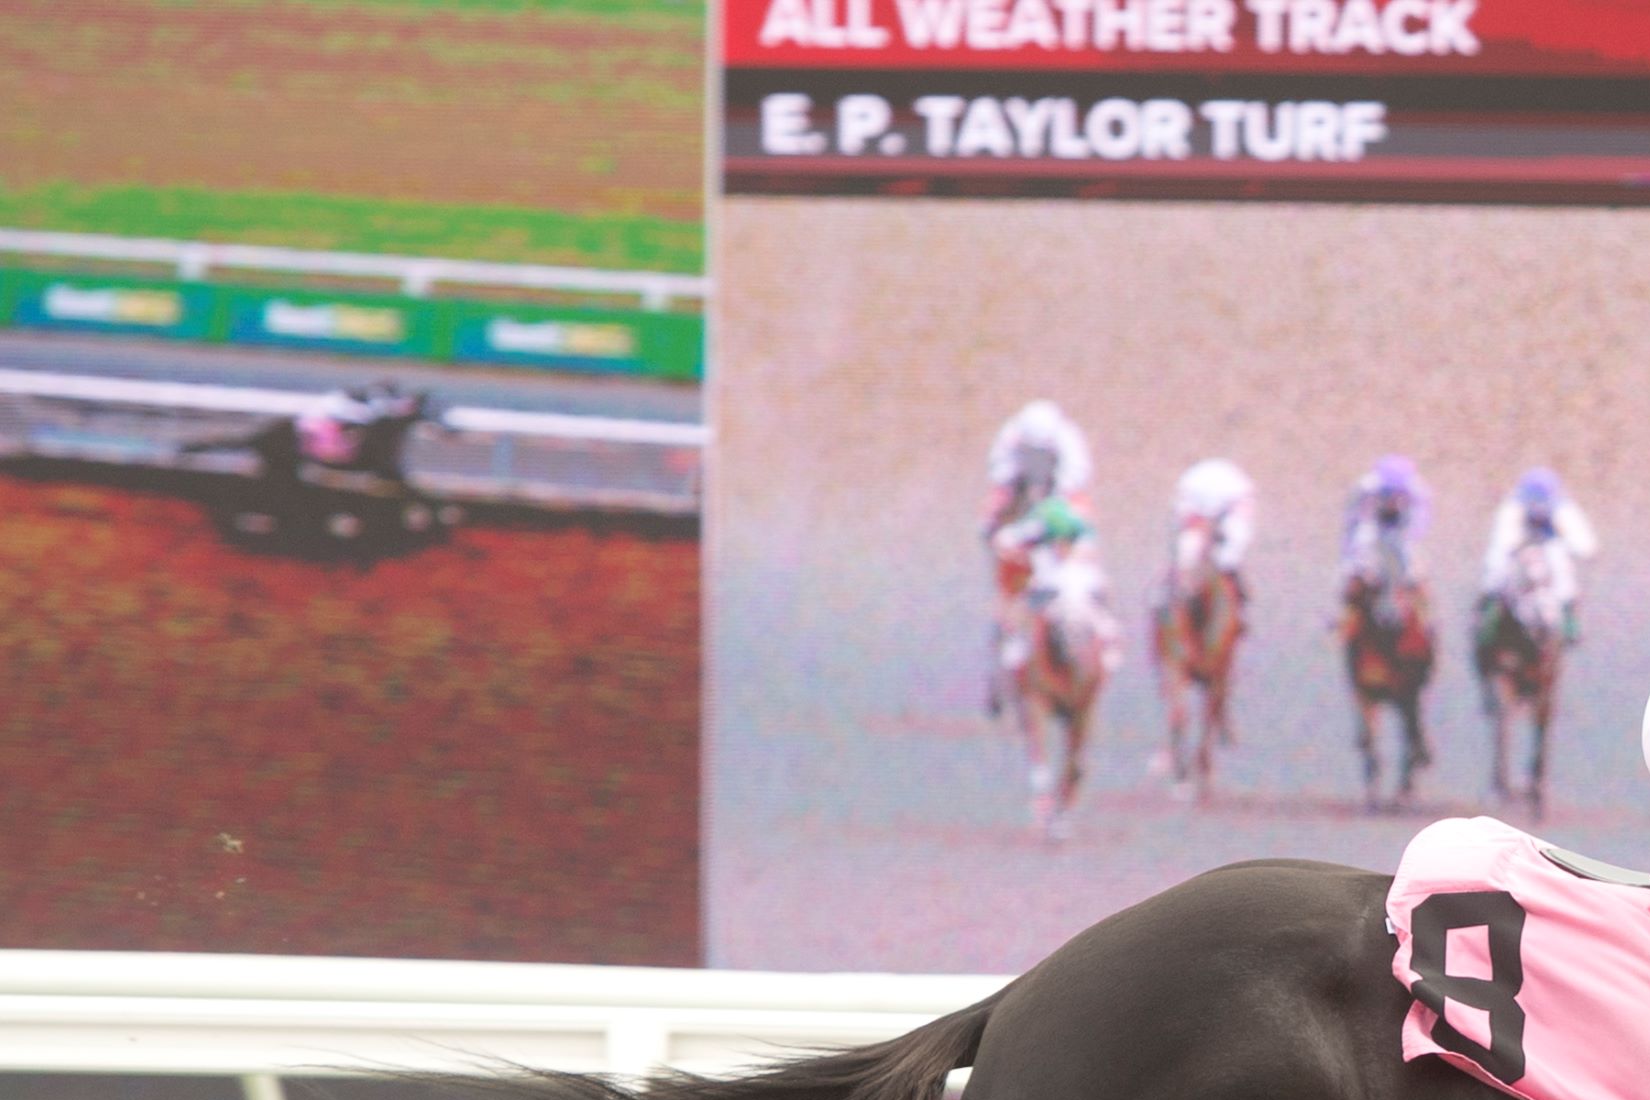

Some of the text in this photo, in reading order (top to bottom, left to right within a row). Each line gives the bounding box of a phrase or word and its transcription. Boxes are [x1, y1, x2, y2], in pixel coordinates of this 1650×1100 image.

[758, 0, 1481, 55] ALL WEATHER TRACK
[761, 92, 1388, 162] E. P. TAYLOR TURF
[1411, 891, 1526, 1084] 8
